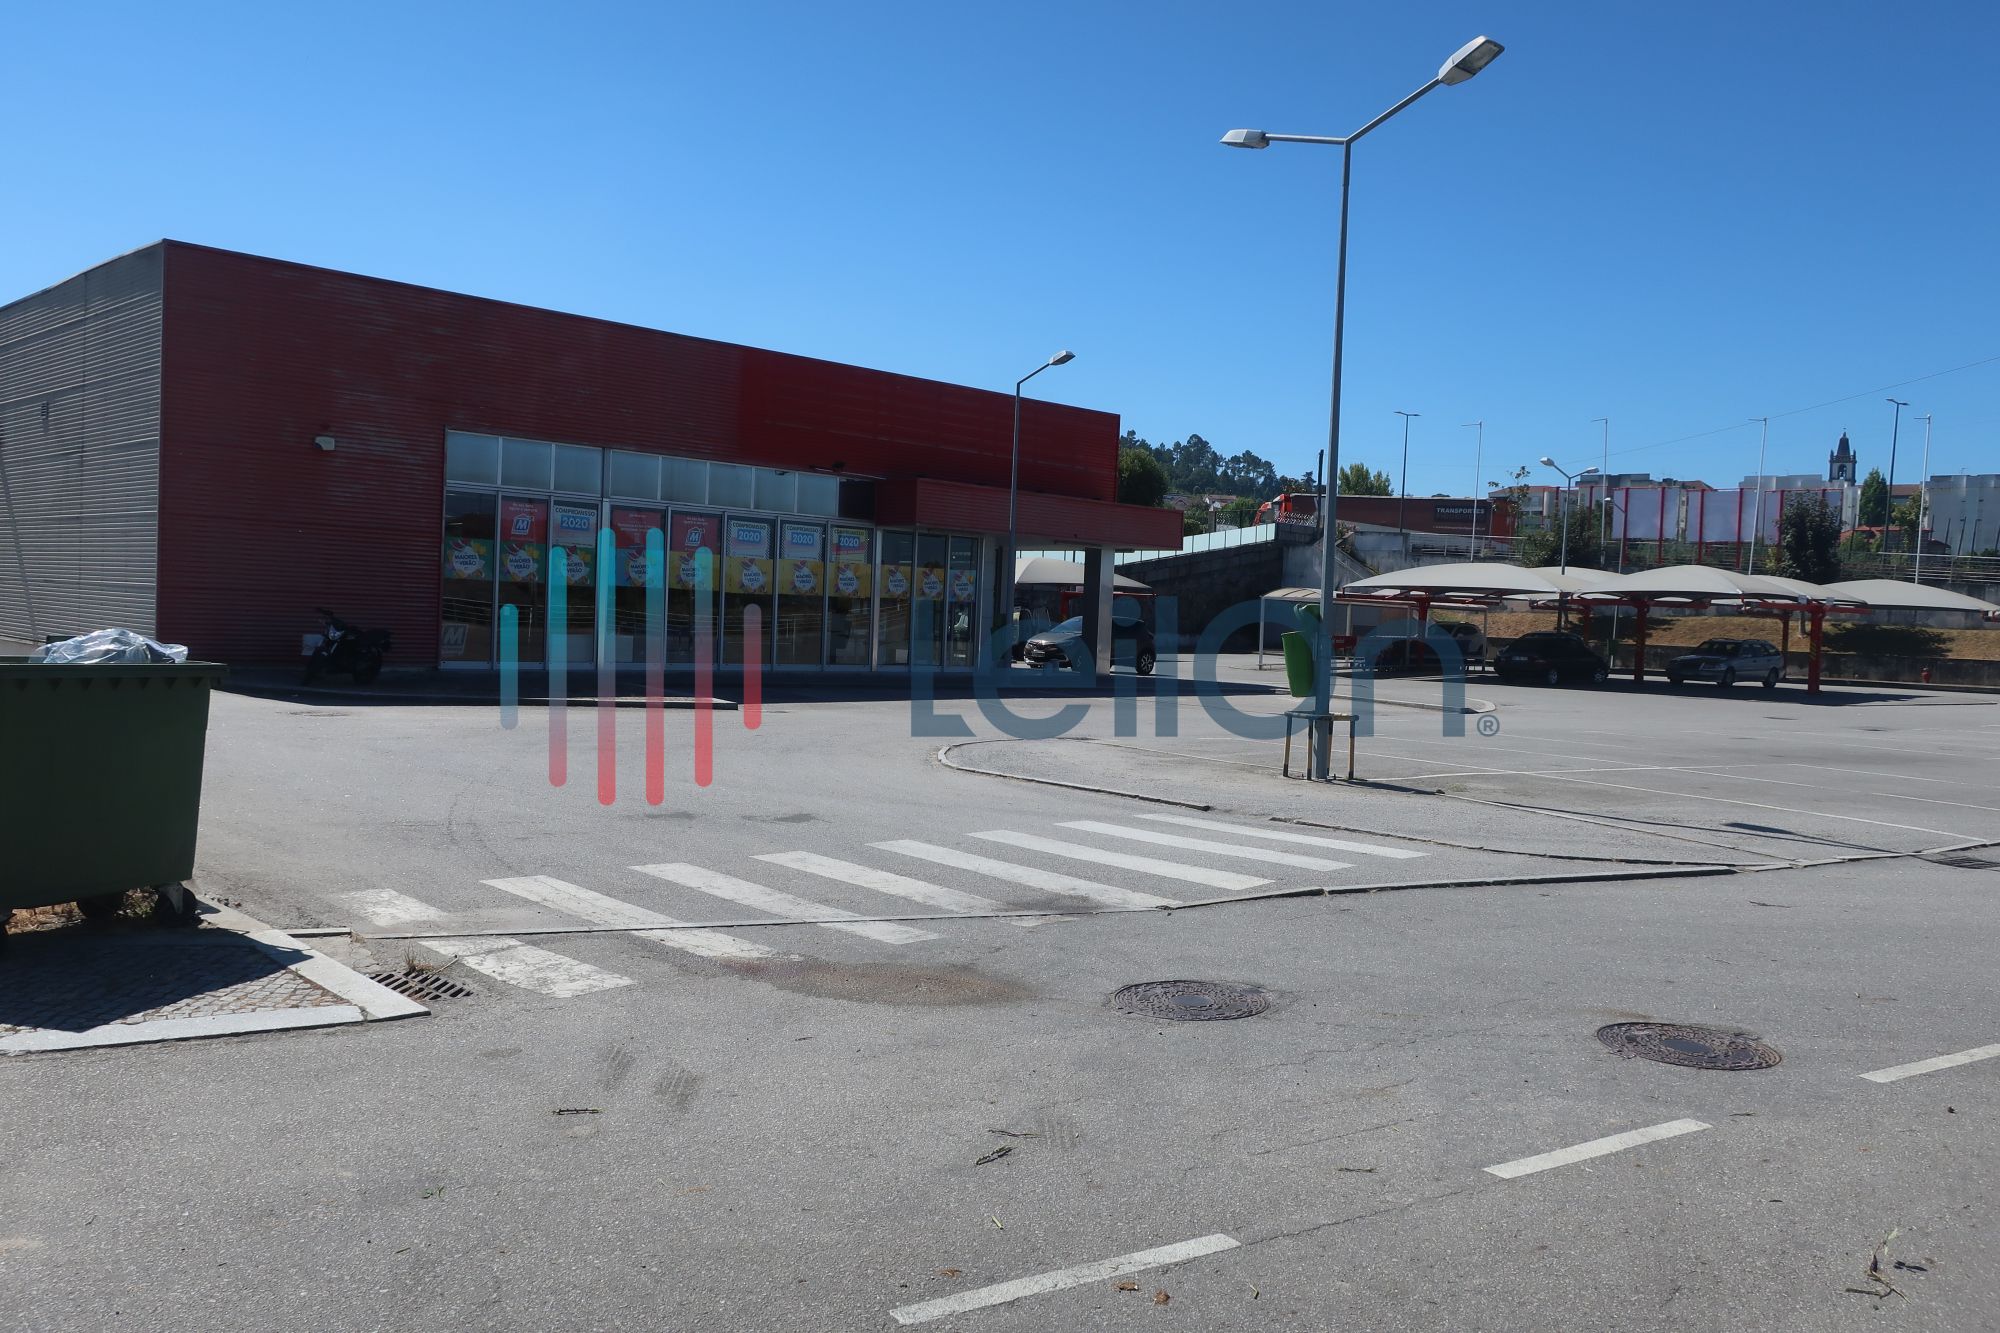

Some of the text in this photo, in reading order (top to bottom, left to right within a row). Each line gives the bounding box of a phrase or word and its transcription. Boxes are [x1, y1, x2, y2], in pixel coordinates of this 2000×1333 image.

[555, 507, 596, 517] COMPROMISSO
[562, 517, 589, 529] 2020
[733, 522, 766, 530] COMPROMISSO
[786, 525, 819, 533] COMPROMISSO
[738, 530, 760, 542] 2020
[792, 534, 814, 544] 2020
[839, 536, 860, 547] 2020
